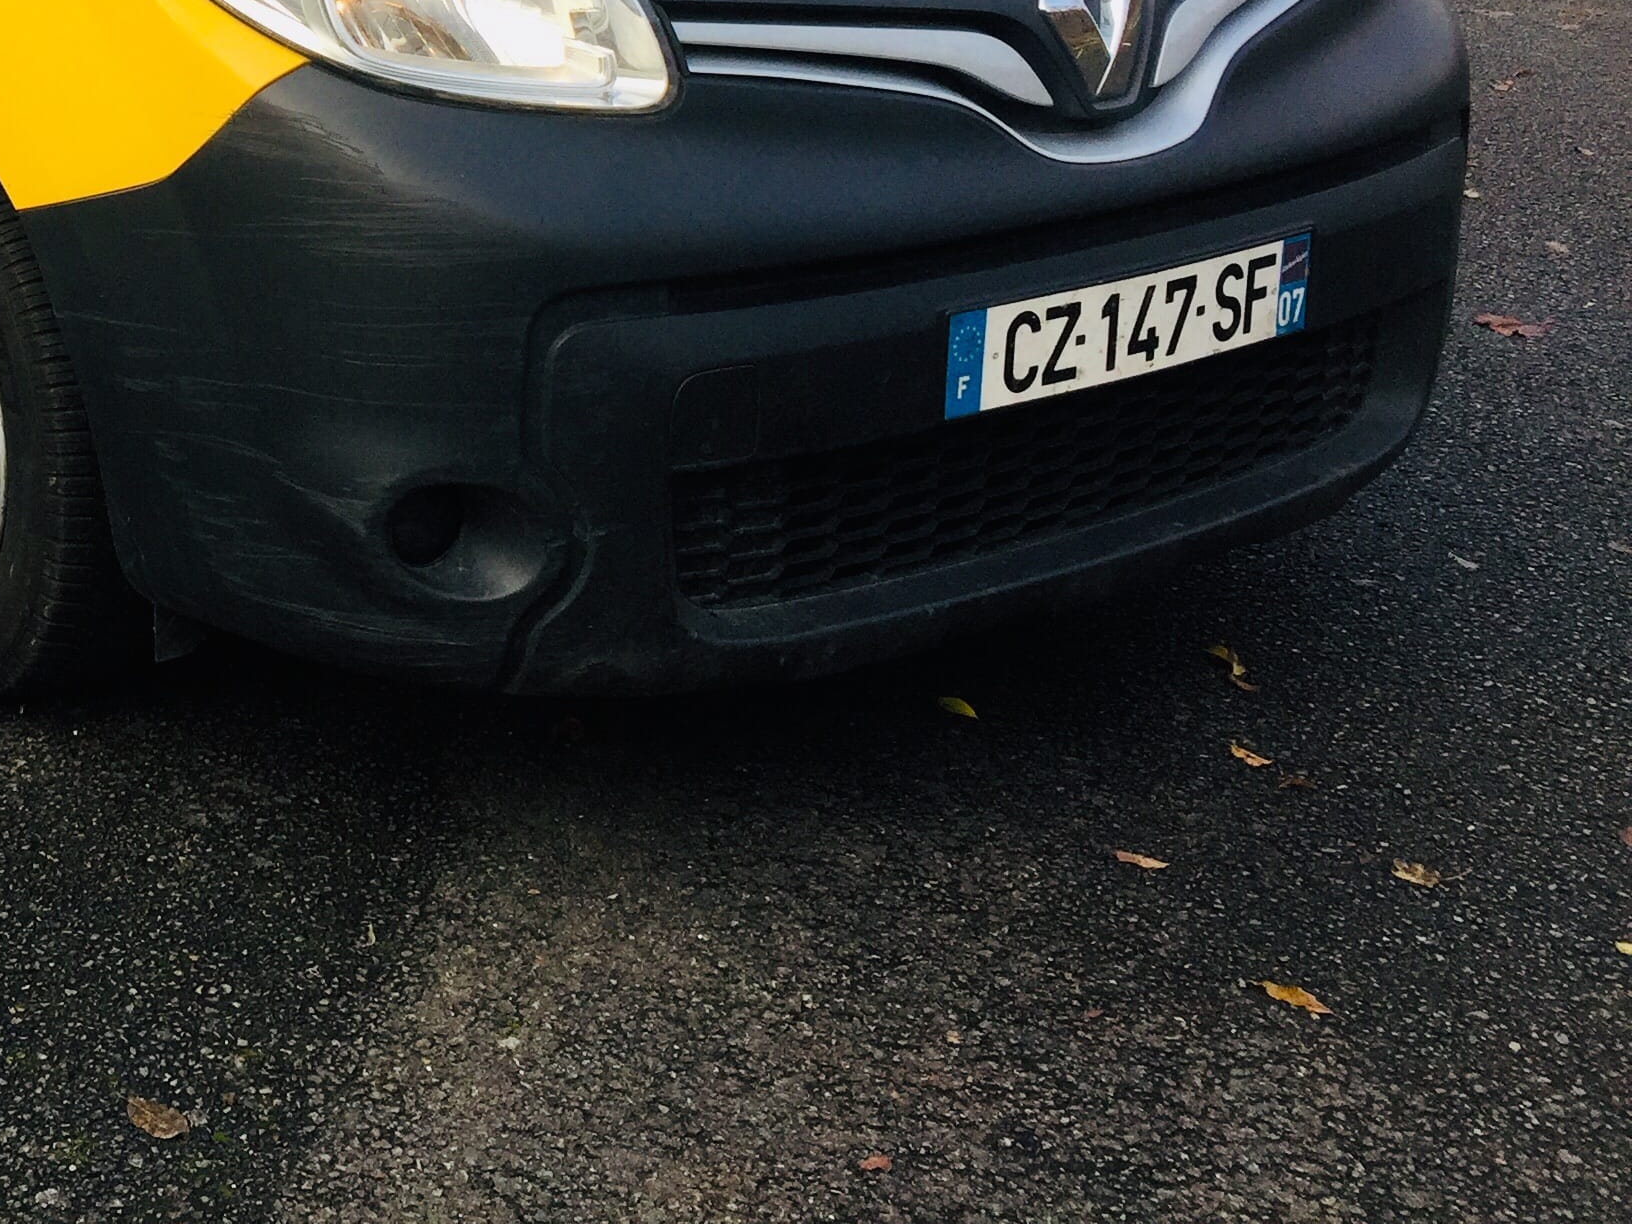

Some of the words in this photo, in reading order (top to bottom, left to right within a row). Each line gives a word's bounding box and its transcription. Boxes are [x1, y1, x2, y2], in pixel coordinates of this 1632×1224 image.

[1002, 253, 1278, 394] CZ-147-SF
[1278, 287, 1306, 327] 07
[956, 375, 971, 400] F
